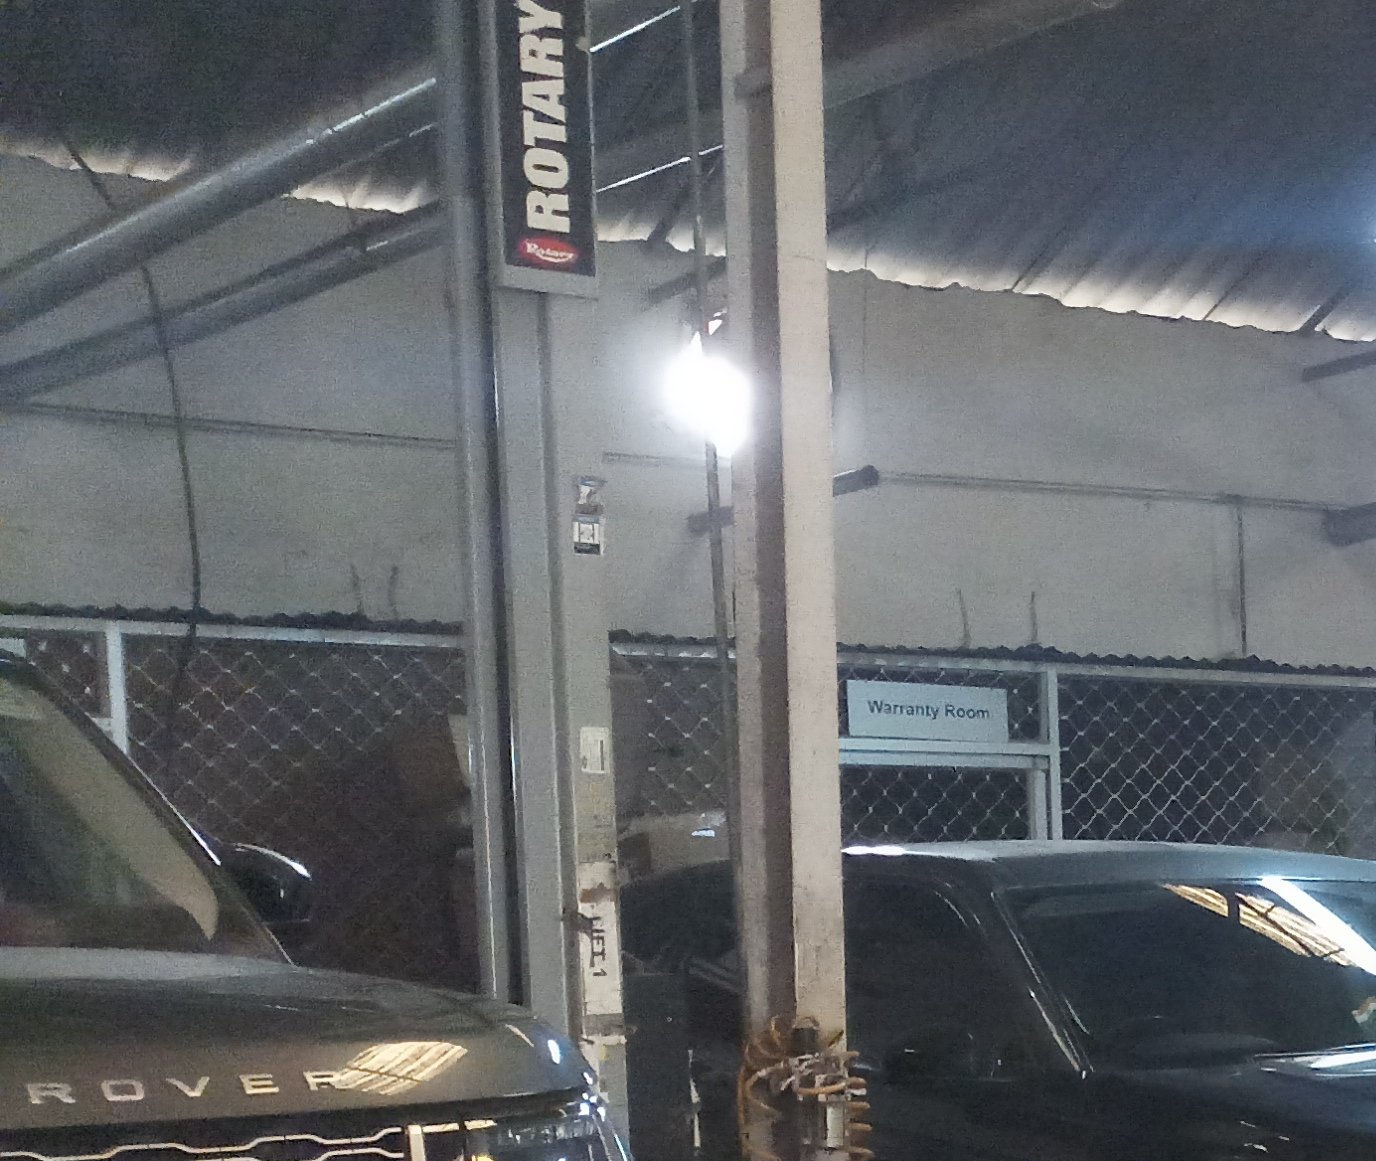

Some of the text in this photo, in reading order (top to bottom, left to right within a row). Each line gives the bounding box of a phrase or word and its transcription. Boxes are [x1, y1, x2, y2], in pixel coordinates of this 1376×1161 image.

[517, 0, 571, 233] ROTARY
[867, 700, 990, 720] Warranty Room
[26, 1070, 354, 1104] ROVER
